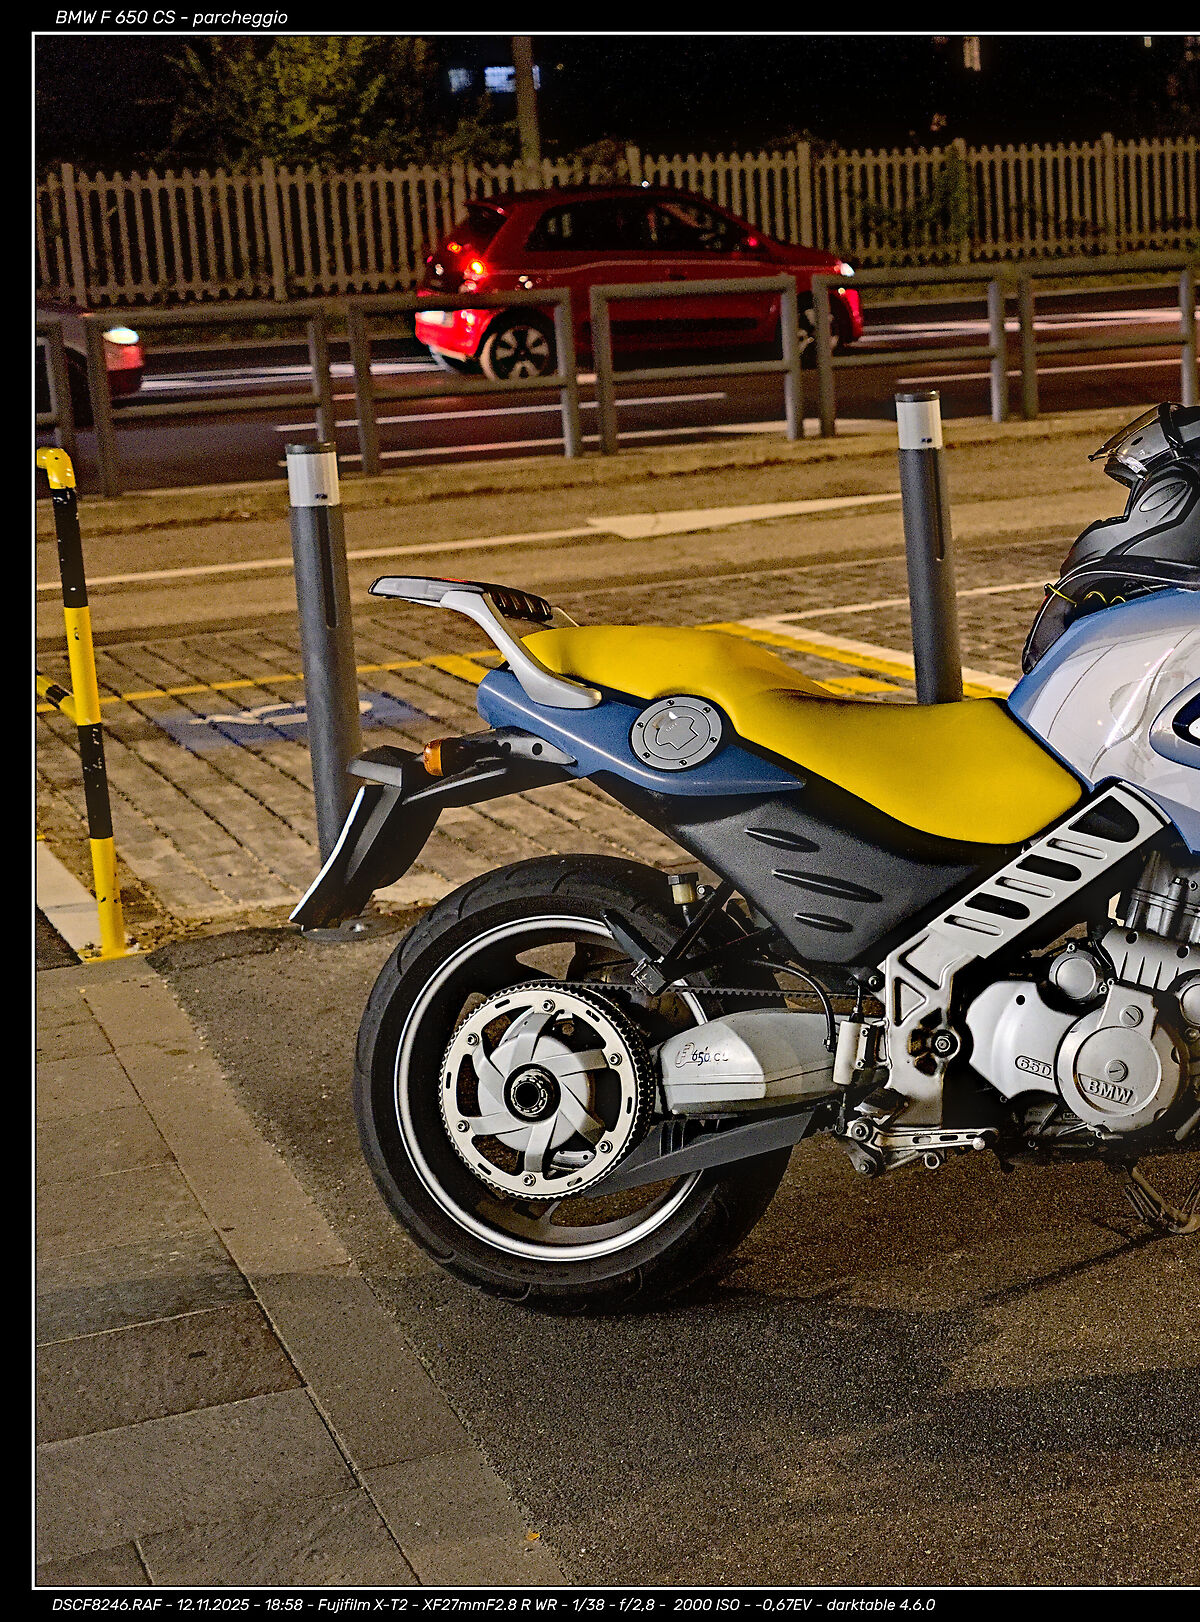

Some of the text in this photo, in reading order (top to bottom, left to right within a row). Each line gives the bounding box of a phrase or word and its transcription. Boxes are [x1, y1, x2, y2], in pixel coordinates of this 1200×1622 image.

[691, 1046, 711, 1067] 650
[1020, 1059, 1052, 1076] 650
[1088, 1079, 1134, 1106] BMW
